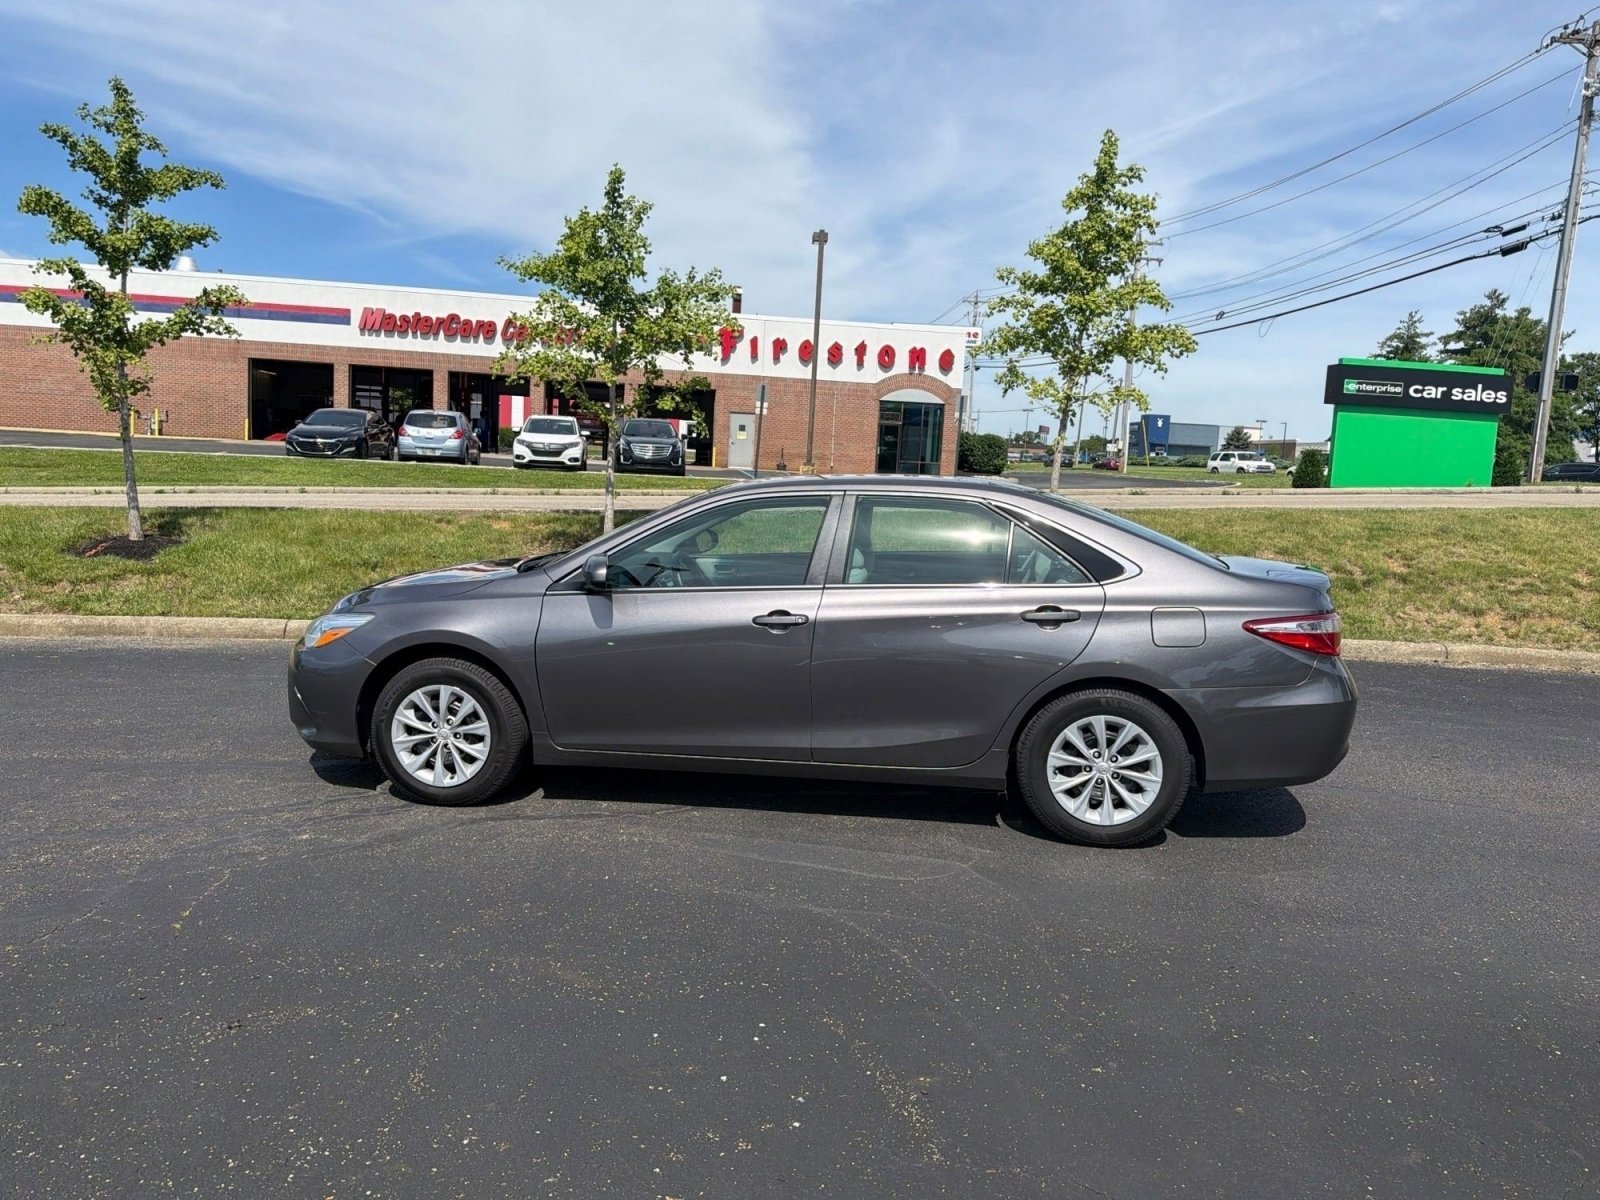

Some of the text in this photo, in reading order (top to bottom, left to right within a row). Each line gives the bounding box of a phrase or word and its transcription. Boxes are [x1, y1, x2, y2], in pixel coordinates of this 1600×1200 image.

[358, 307, 497, 341] MasterCare
[716, 324, 956, 372] Firestone
[1346, 383, 1507, 404] enterprise car sales
